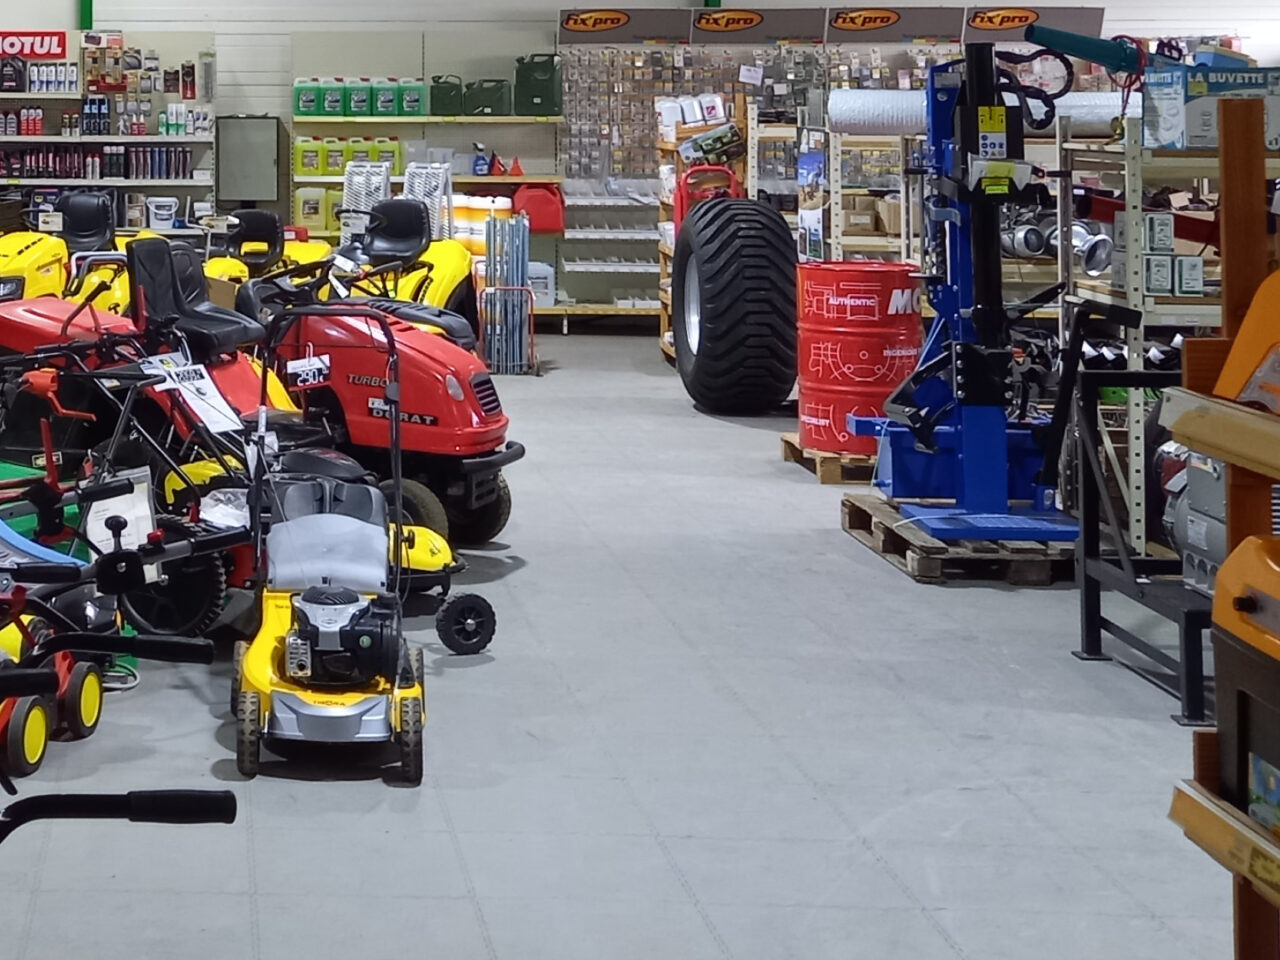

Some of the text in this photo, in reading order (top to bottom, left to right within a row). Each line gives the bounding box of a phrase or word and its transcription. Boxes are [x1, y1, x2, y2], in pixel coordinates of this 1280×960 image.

[1186, 72, 1264, 83] LA BUVETTE
[347, 374, 389, 387] TURBO
